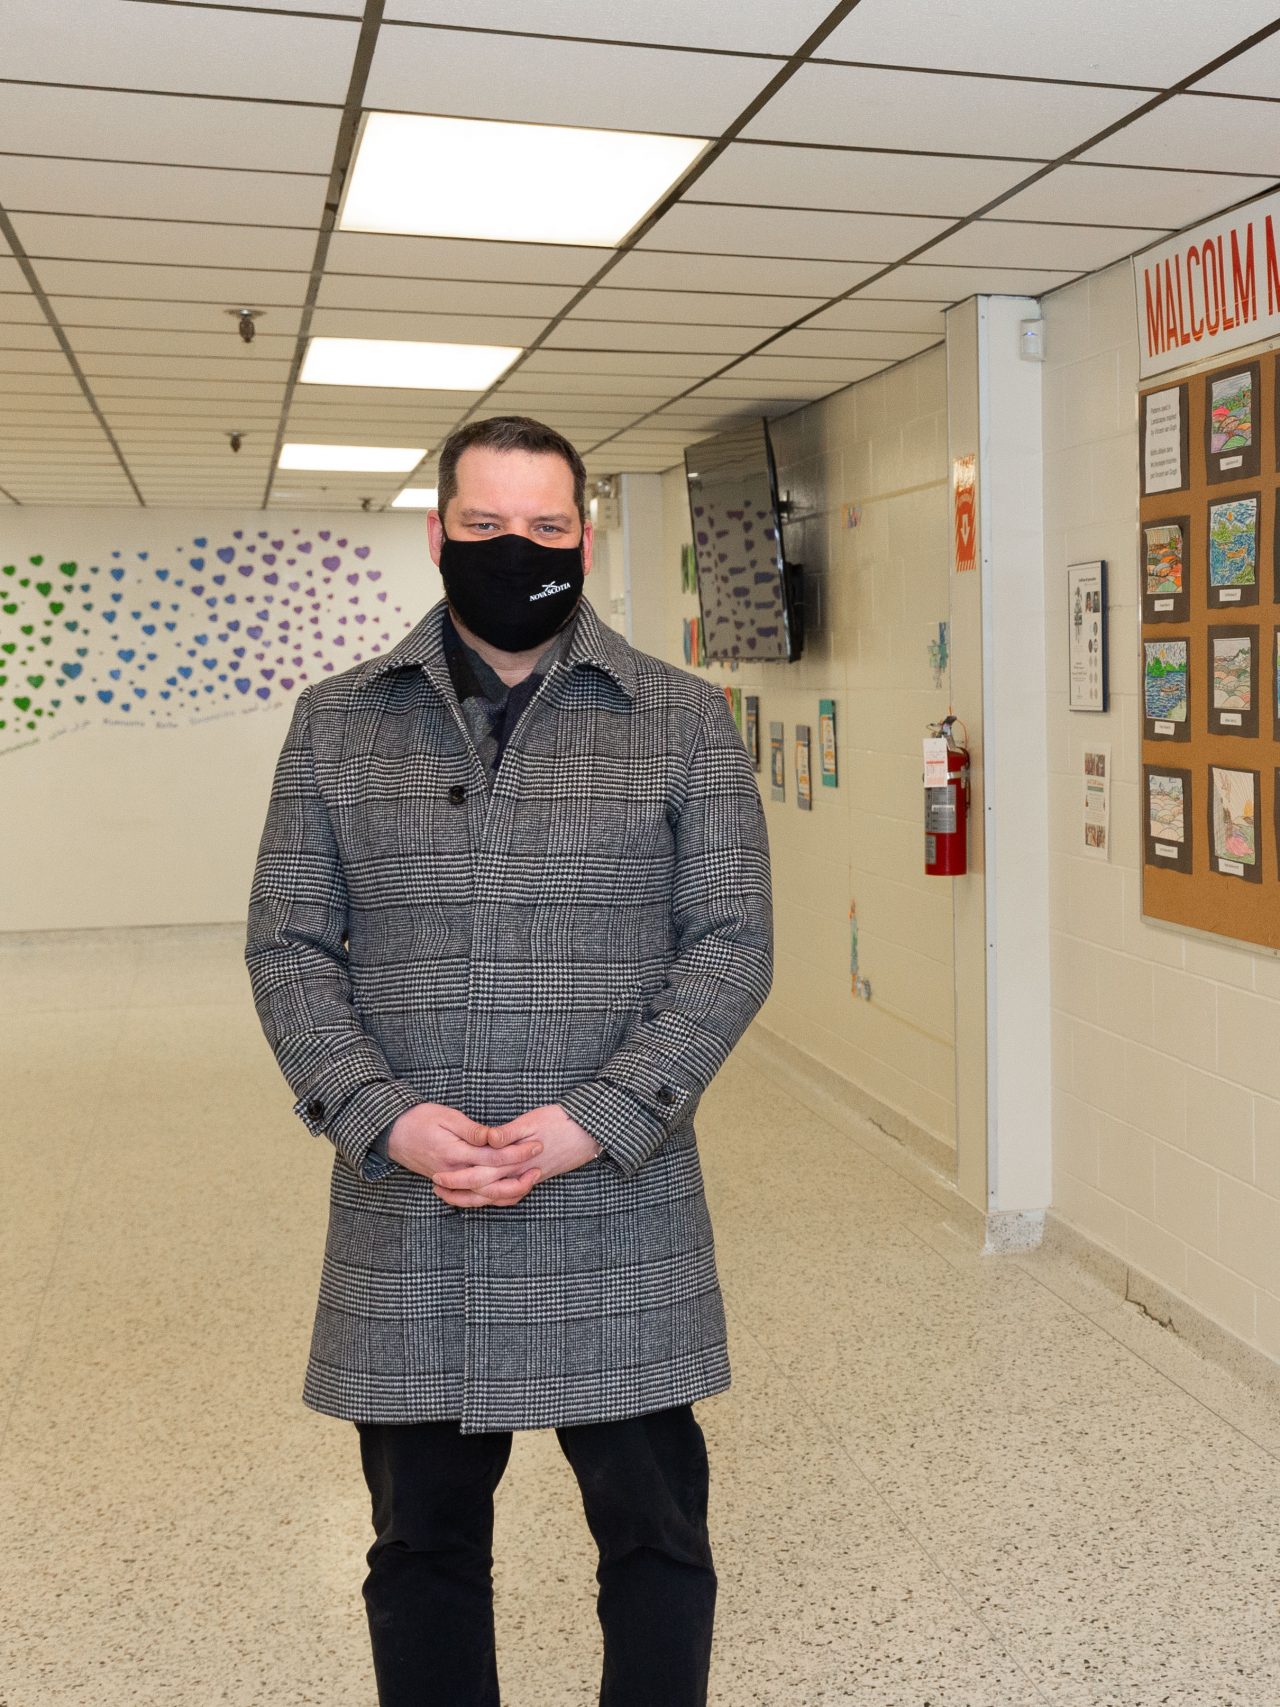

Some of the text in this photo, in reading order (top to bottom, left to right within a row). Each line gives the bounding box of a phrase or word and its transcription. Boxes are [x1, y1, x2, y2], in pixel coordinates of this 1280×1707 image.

[1143, 222, 1257, 358] MALCOLM
[529, 582, 571, 602] NOVA SCOTIA
